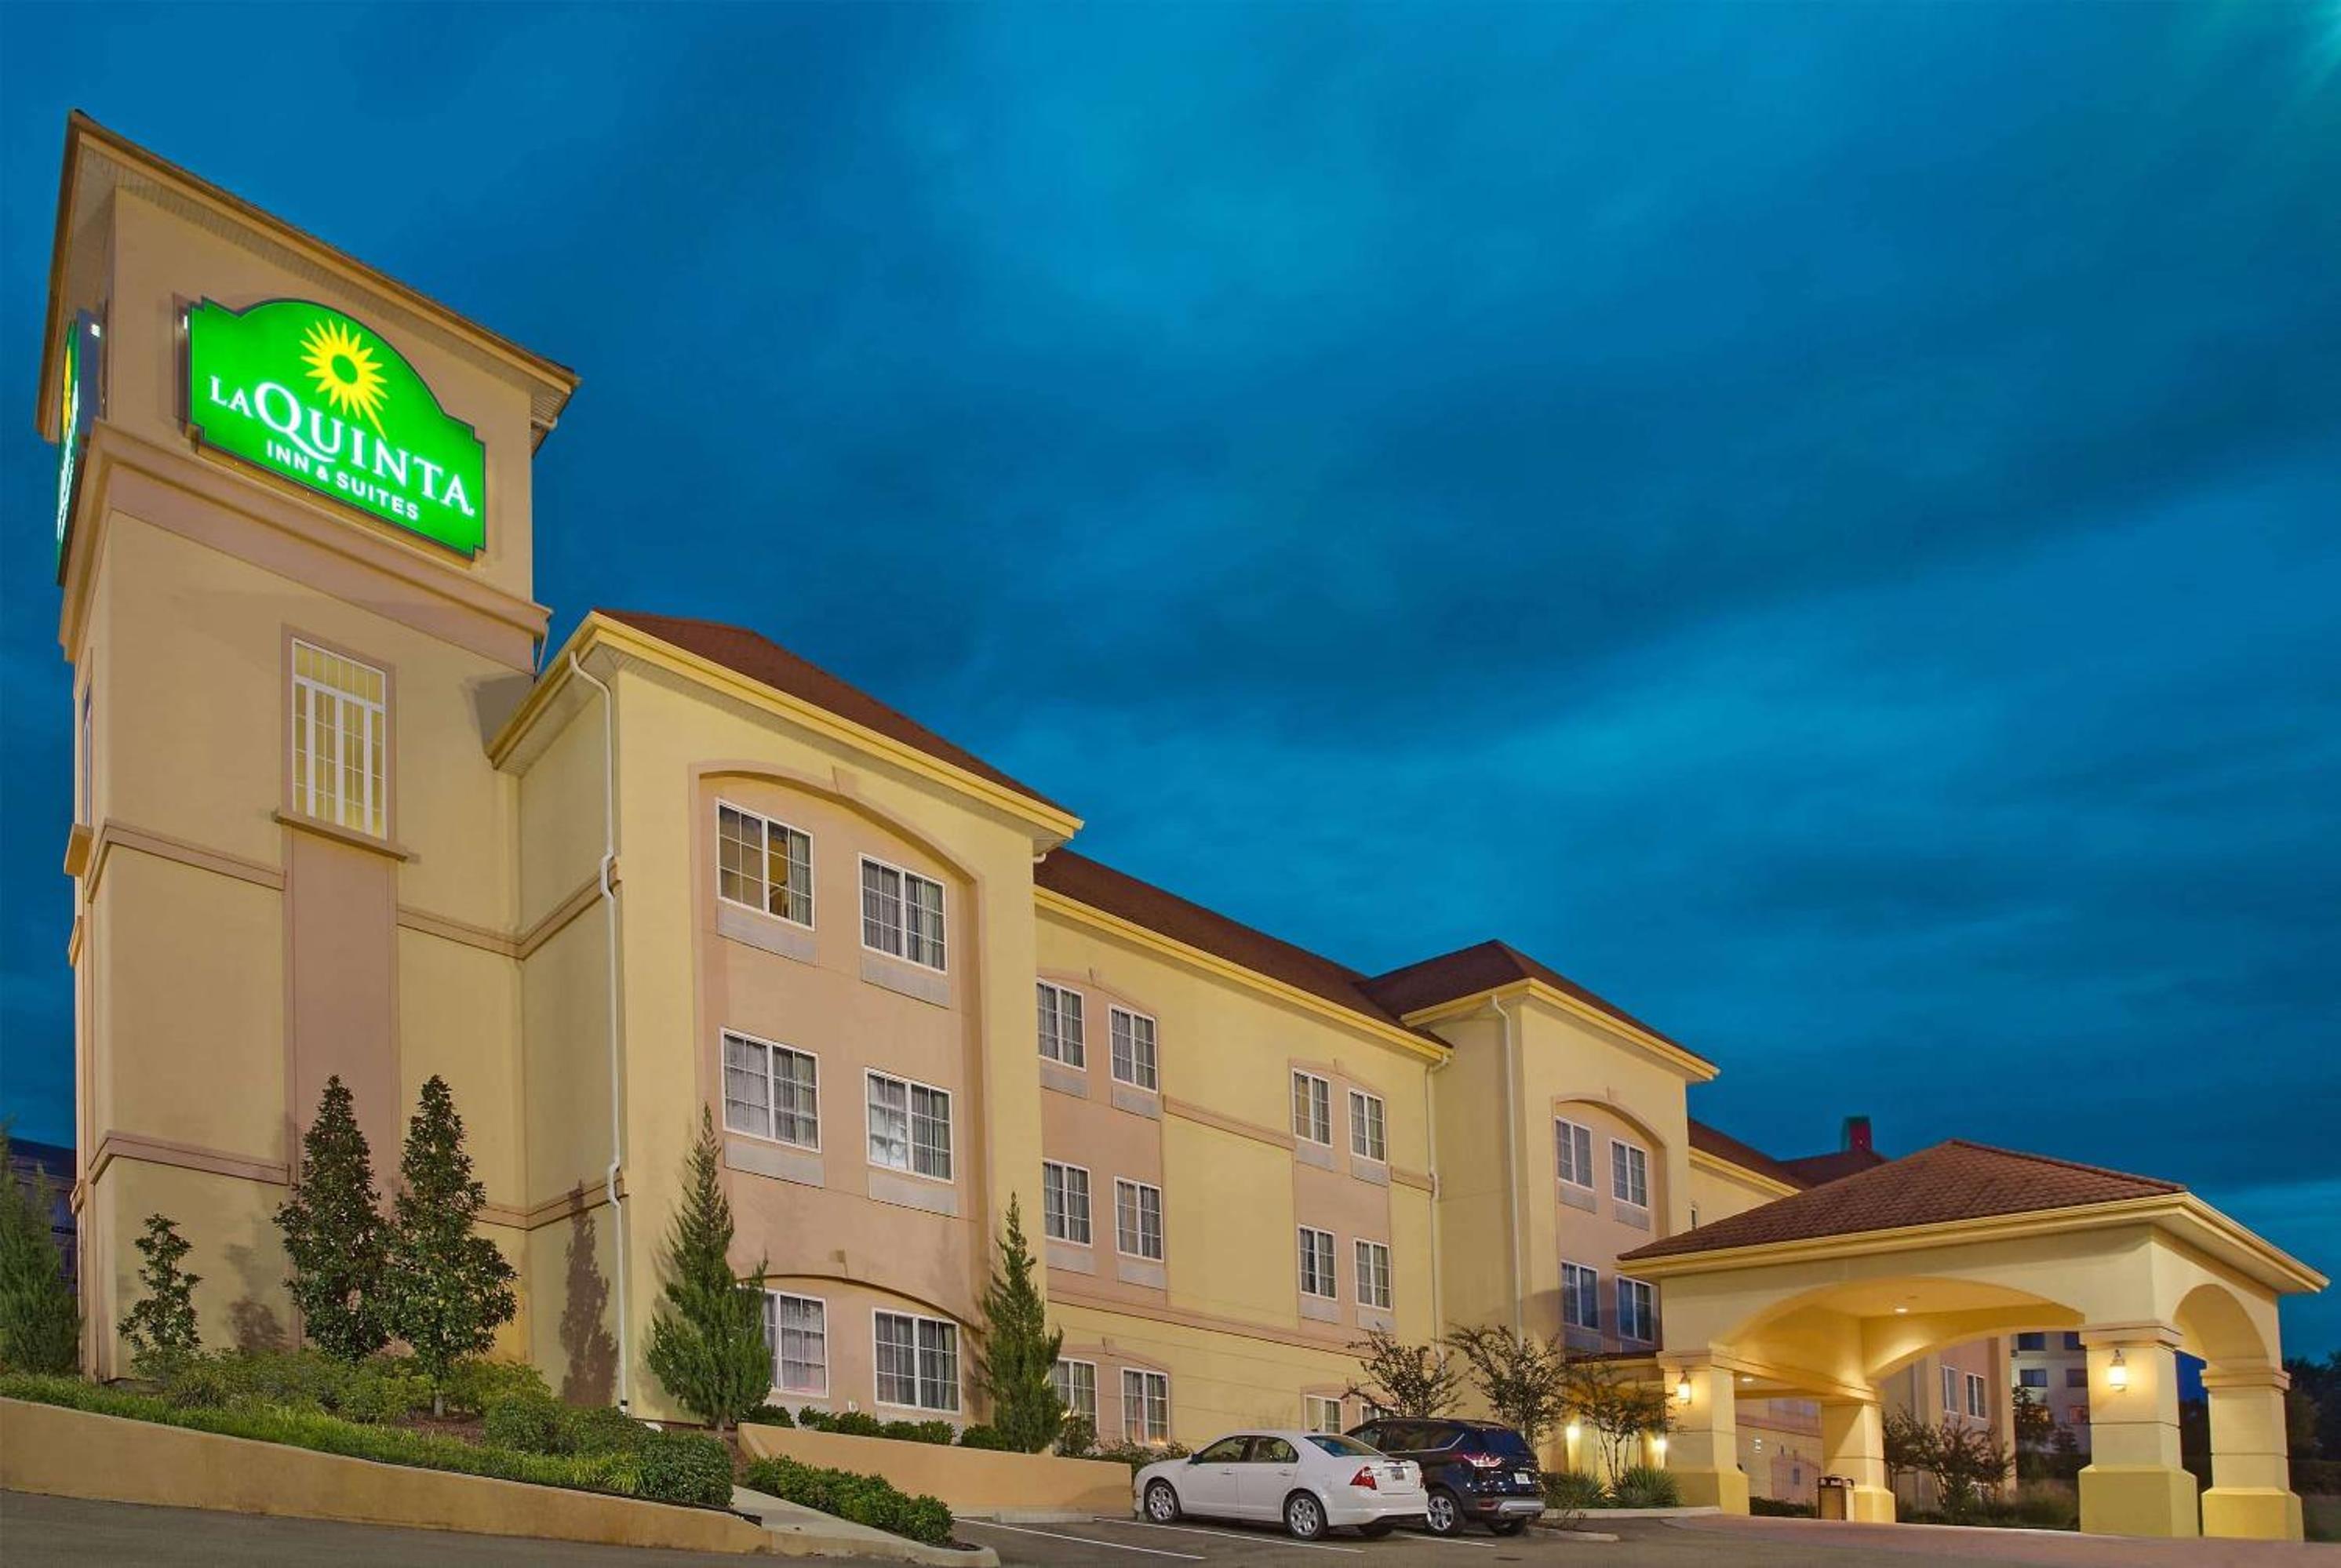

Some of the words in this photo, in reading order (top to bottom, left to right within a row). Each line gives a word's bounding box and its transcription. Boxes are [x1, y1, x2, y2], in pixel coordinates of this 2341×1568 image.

[209, 375, 253, 418] LA
[254, 381, 475, 518] QUINTA
[266, 439, 310, 474] INN
[315, 464, 329, 482] &
[336, 471, 420, 521] SUITES
